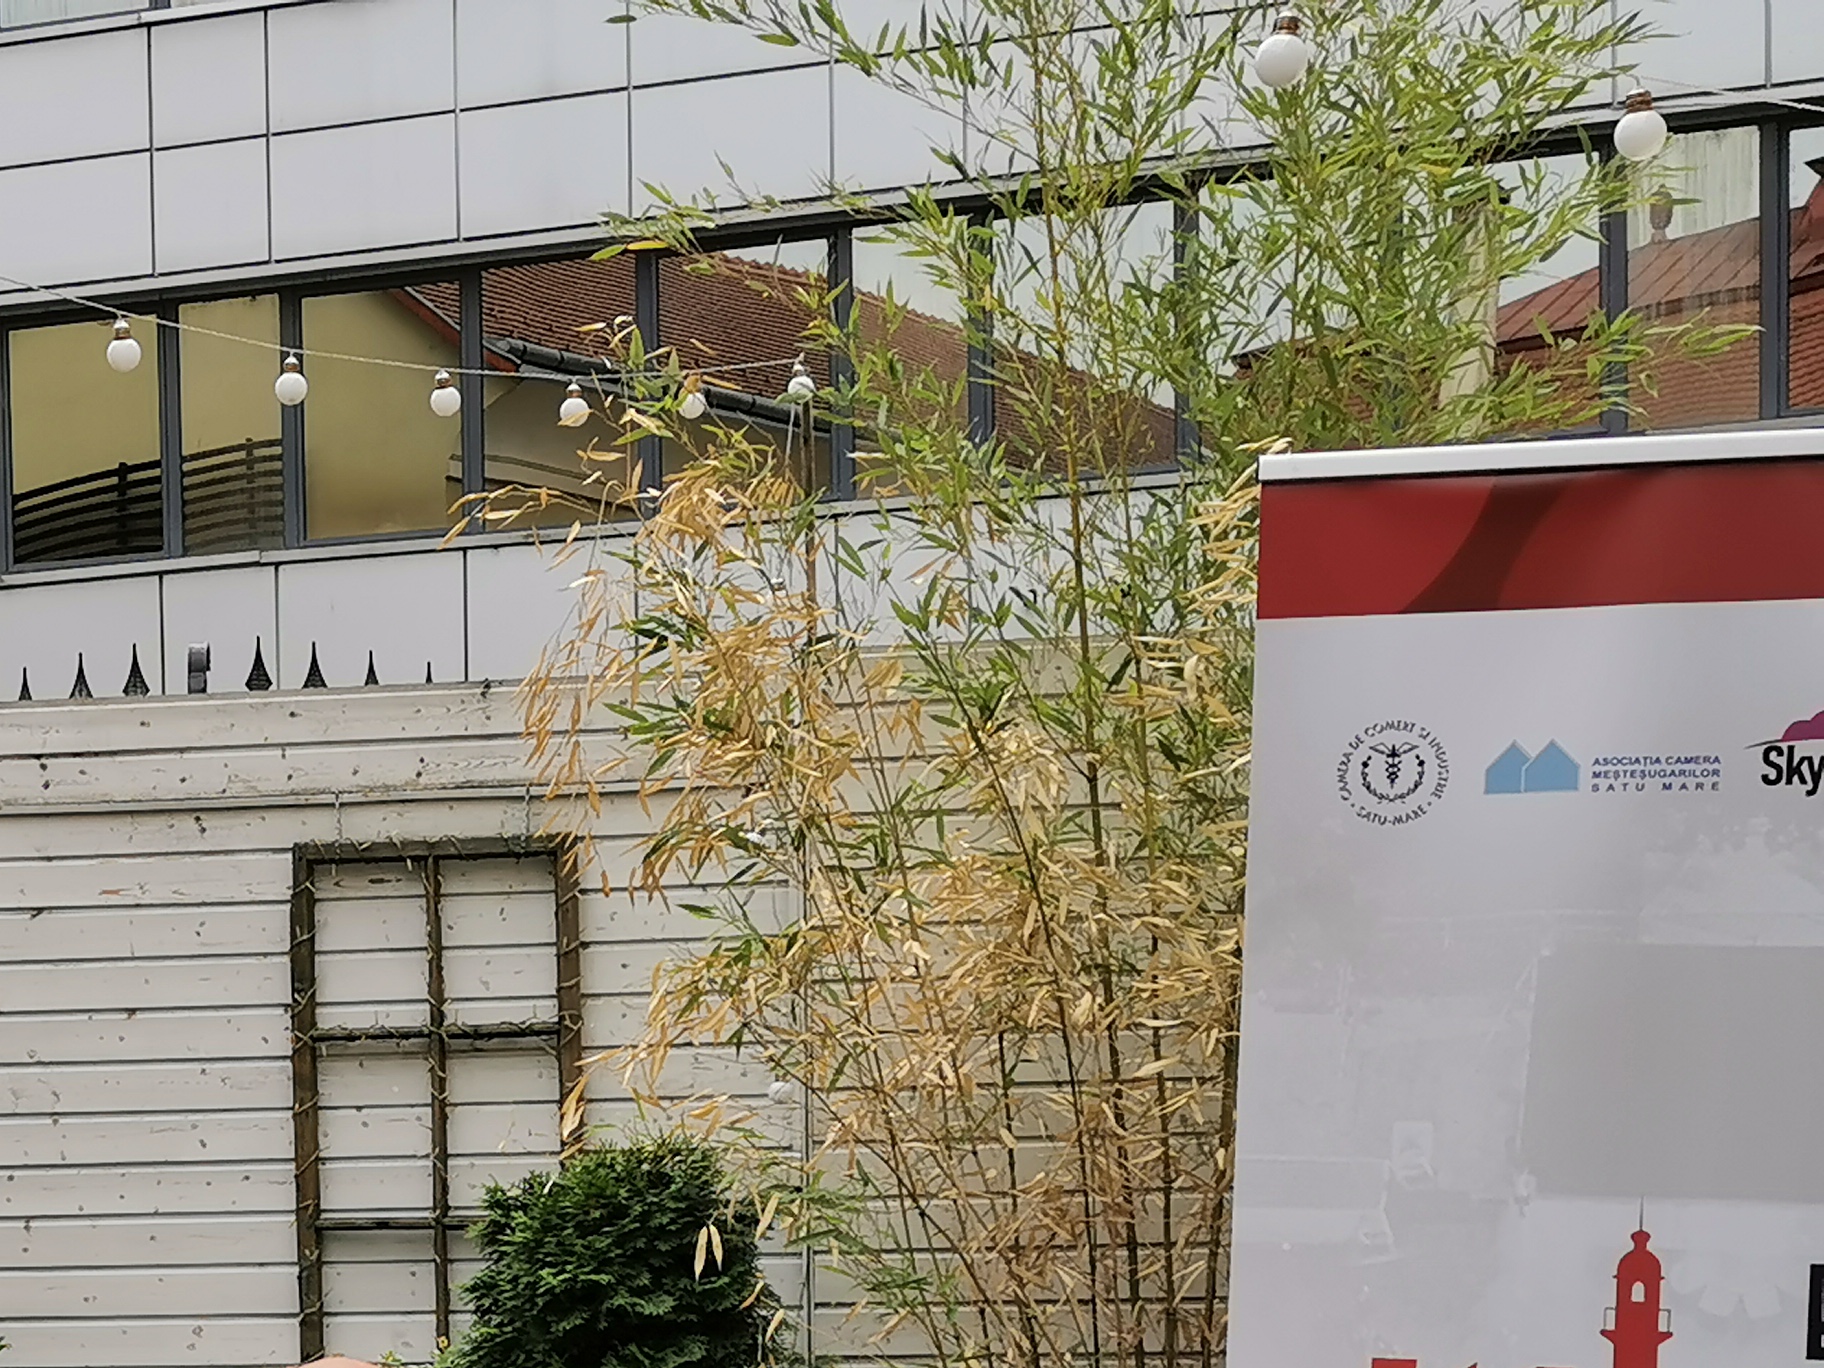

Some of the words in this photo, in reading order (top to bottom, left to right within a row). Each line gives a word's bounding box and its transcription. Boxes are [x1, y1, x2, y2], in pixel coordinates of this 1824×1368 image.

[1664, 755, 1722, 766] CAMERA
[1591, 782, 1646, 792] SATU
[1661, 781, 1720, 792] MARE
